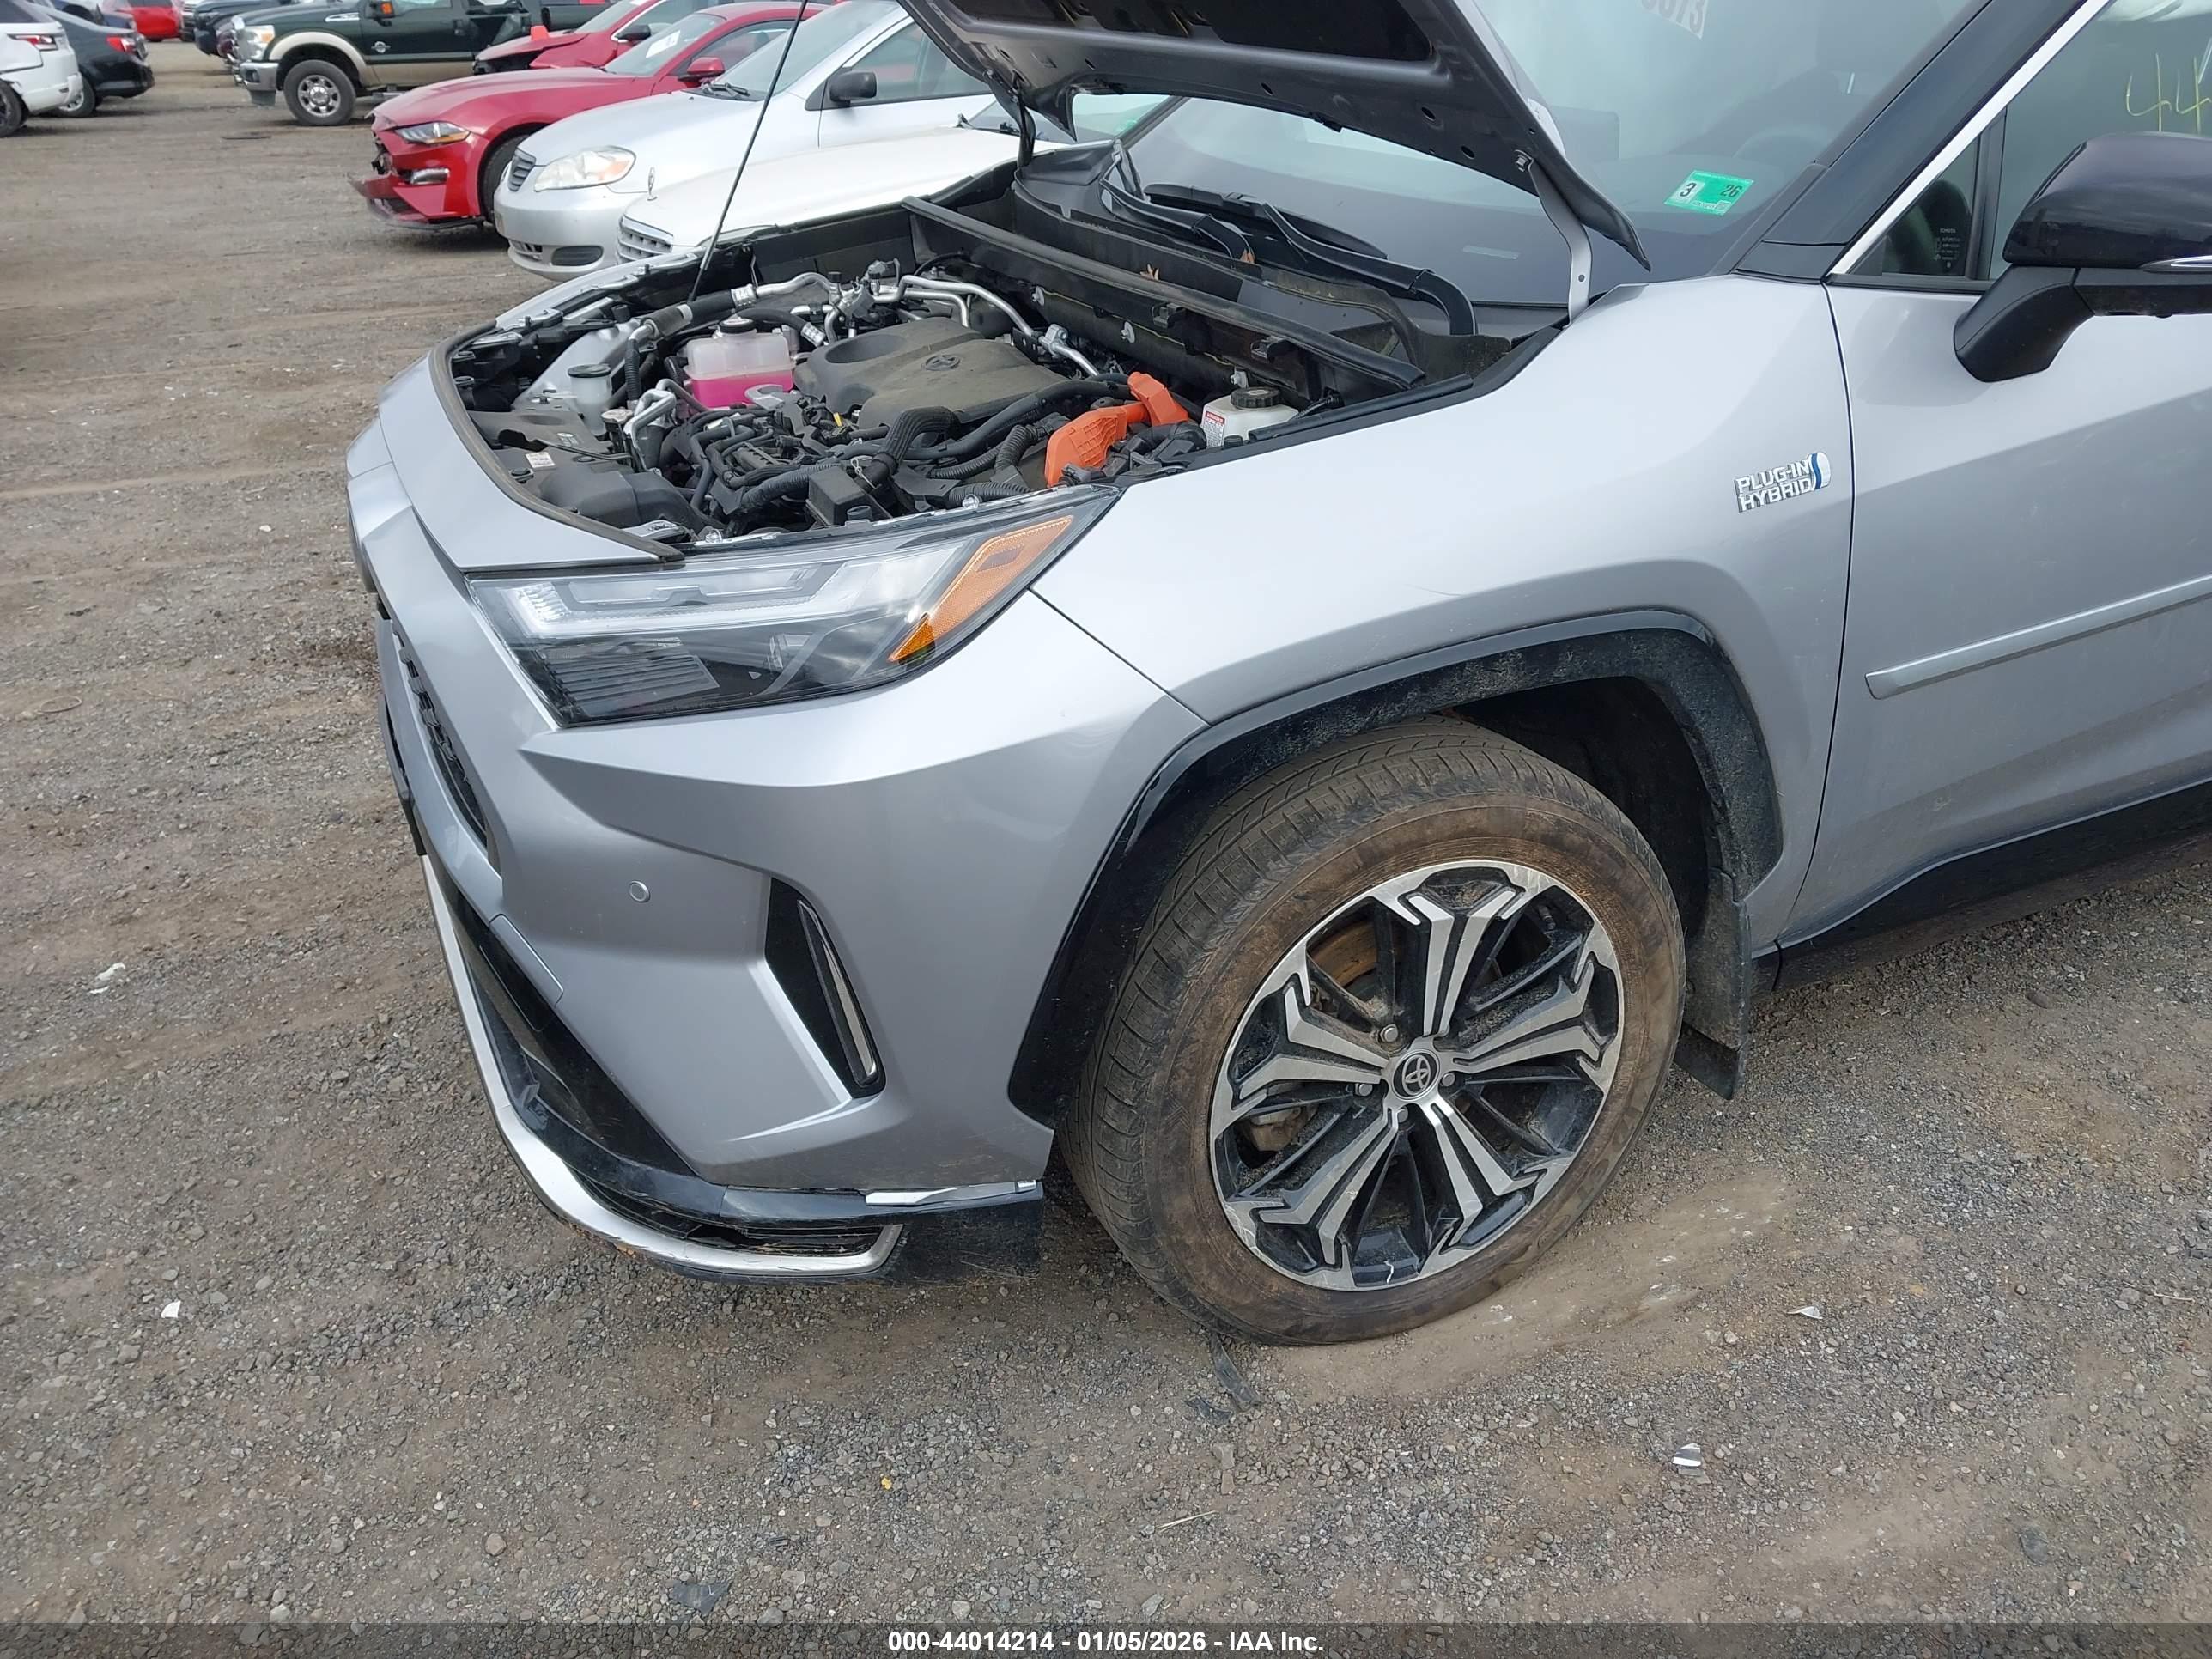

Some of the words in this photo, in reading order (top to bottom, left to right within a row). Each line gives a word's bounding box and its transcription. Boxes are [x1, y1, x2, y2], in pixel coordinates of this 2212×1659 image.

[1680, 182, 1697, 198] 3
[1720, 184, 1743, 198] 26
[1735, 459, 1810, 494] PLUG-IN
[1737, 477, 1814, 513] HYBRID
